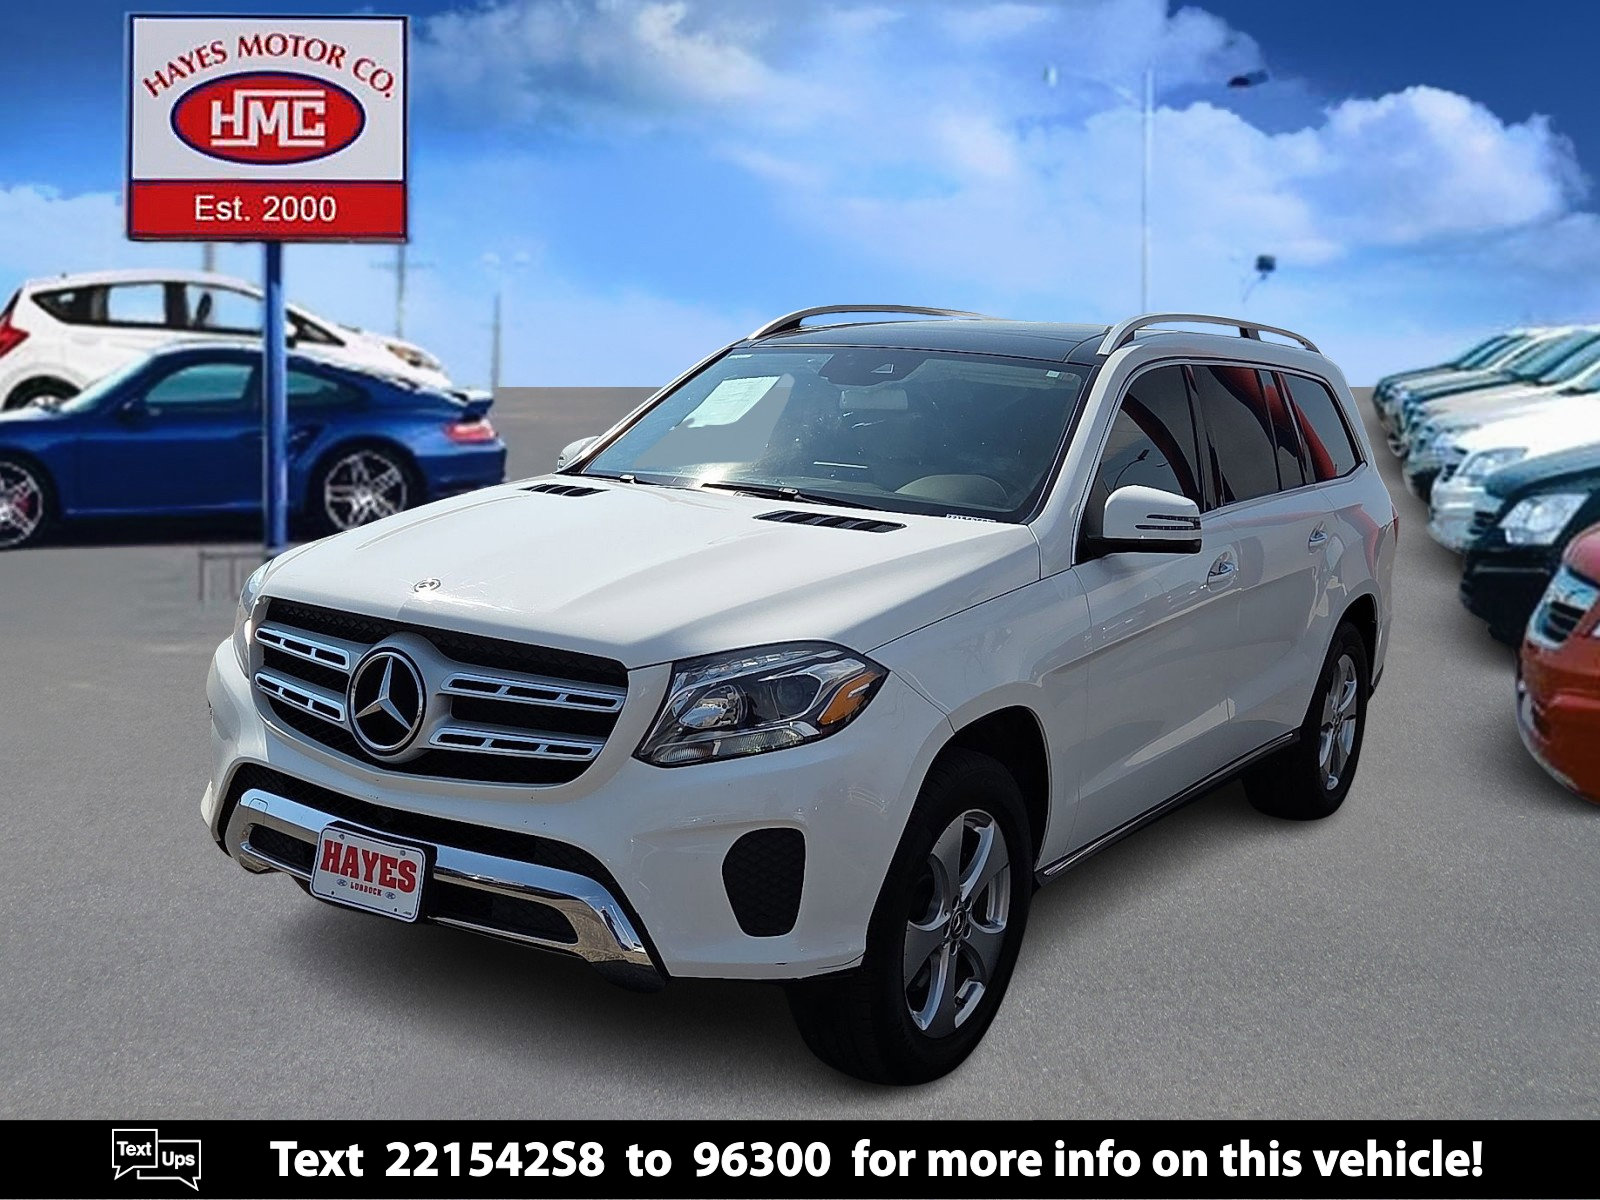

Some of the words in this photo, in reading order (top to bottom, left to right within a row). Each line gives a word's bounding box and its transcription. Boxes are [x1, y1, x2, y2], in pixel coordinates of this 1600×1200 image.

[143, 41, 228, 98] HAYES
[237, 33, 347, 70] MOTOR
[352, 57, 395, 99] CO.
[210, 88, 326, 148] HMC
[194, 194, 251, 222] Est.
[262, 195, 338, 223] 2000
[320, 838, 418, 894] HAYES
[349, 881, 383, 897] LUBBOCK
